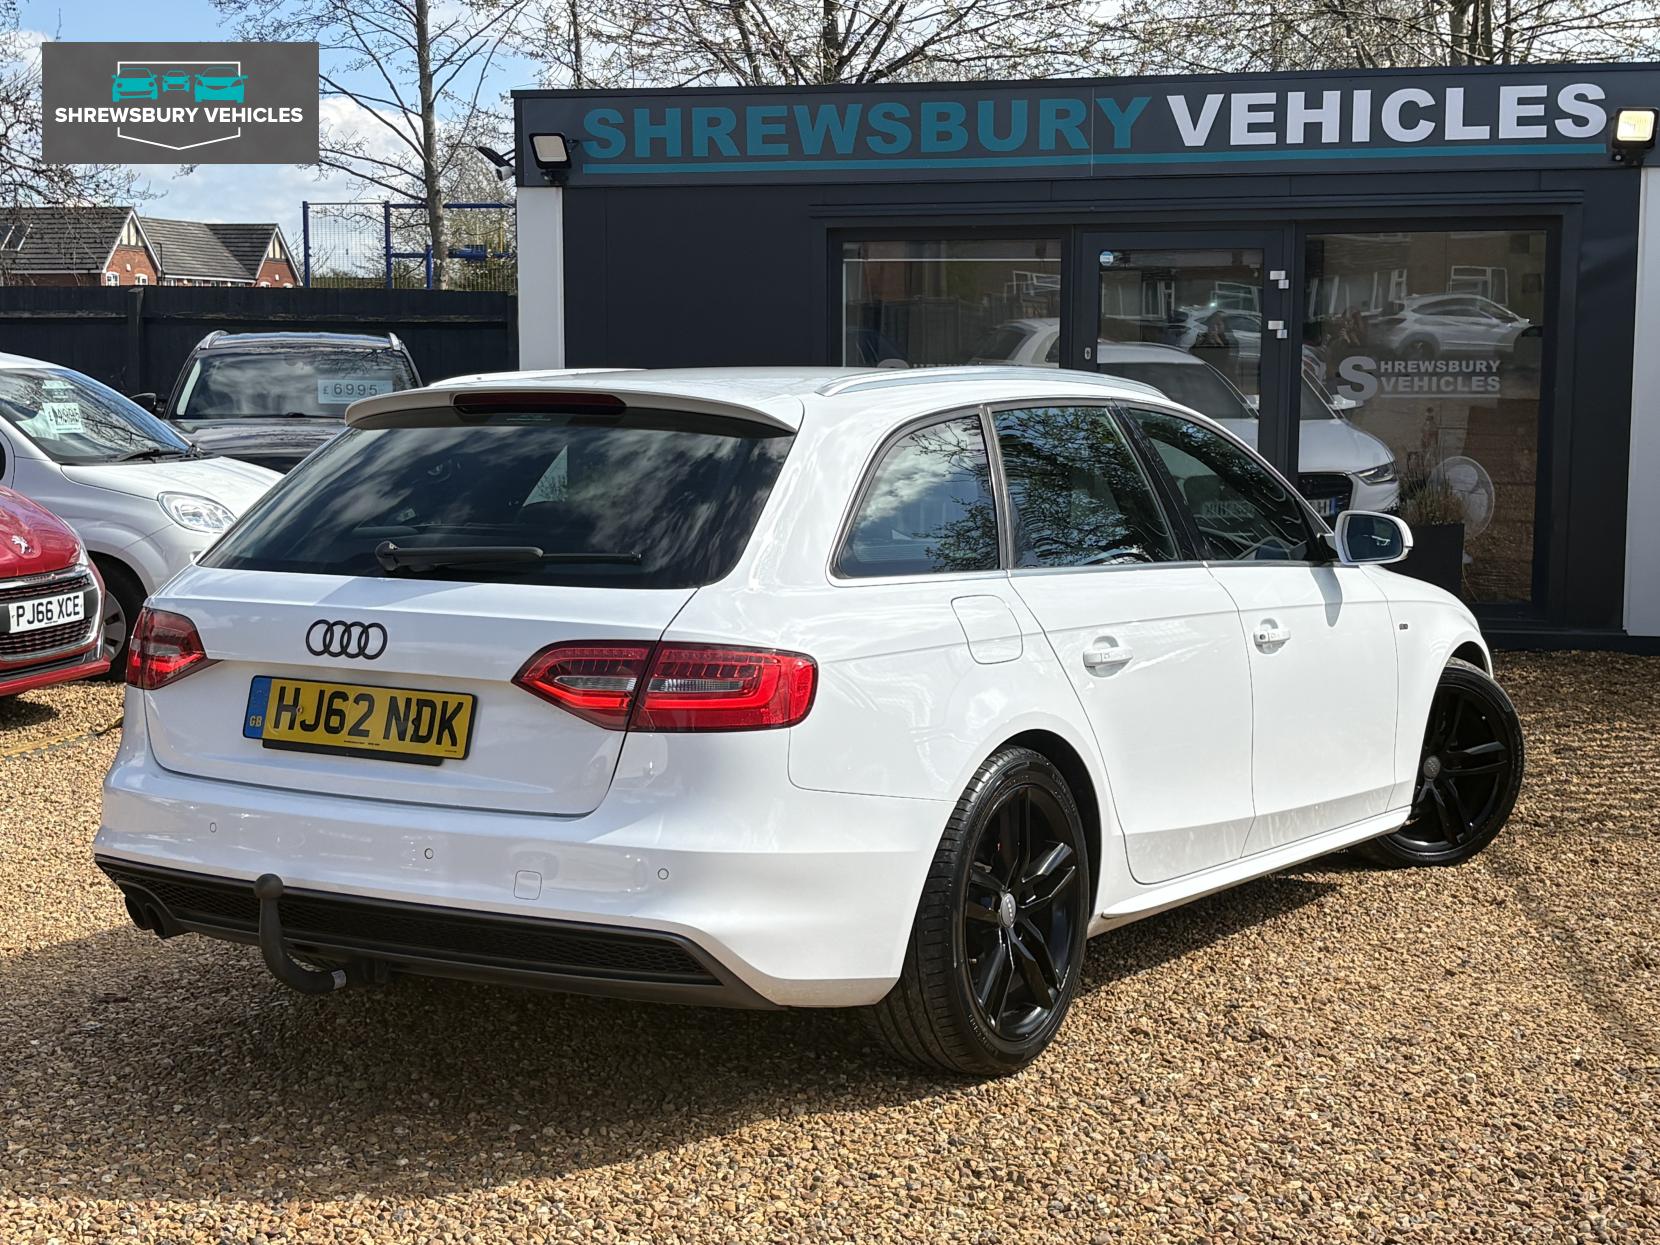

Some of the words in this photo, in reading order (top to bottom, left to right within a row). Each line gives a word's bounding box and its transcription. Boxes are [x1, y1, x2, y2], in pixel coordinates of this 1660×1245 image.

[582, 97, 1151, 159] SHREWSBURY
[1166, 83, 1608, 147] VEHICLES
[1336, 355, 1501, 401] SHREWSBURY
[1381, 376, 1501, 392] VEHICLES
[16, 600, 54, 627] PJ66
[57, 595, 80, 619] XCE
[250, 715, 262, 727] GB
[273, 686, 375, 737] HJ62
[383, 695, 464, 746] NDK
